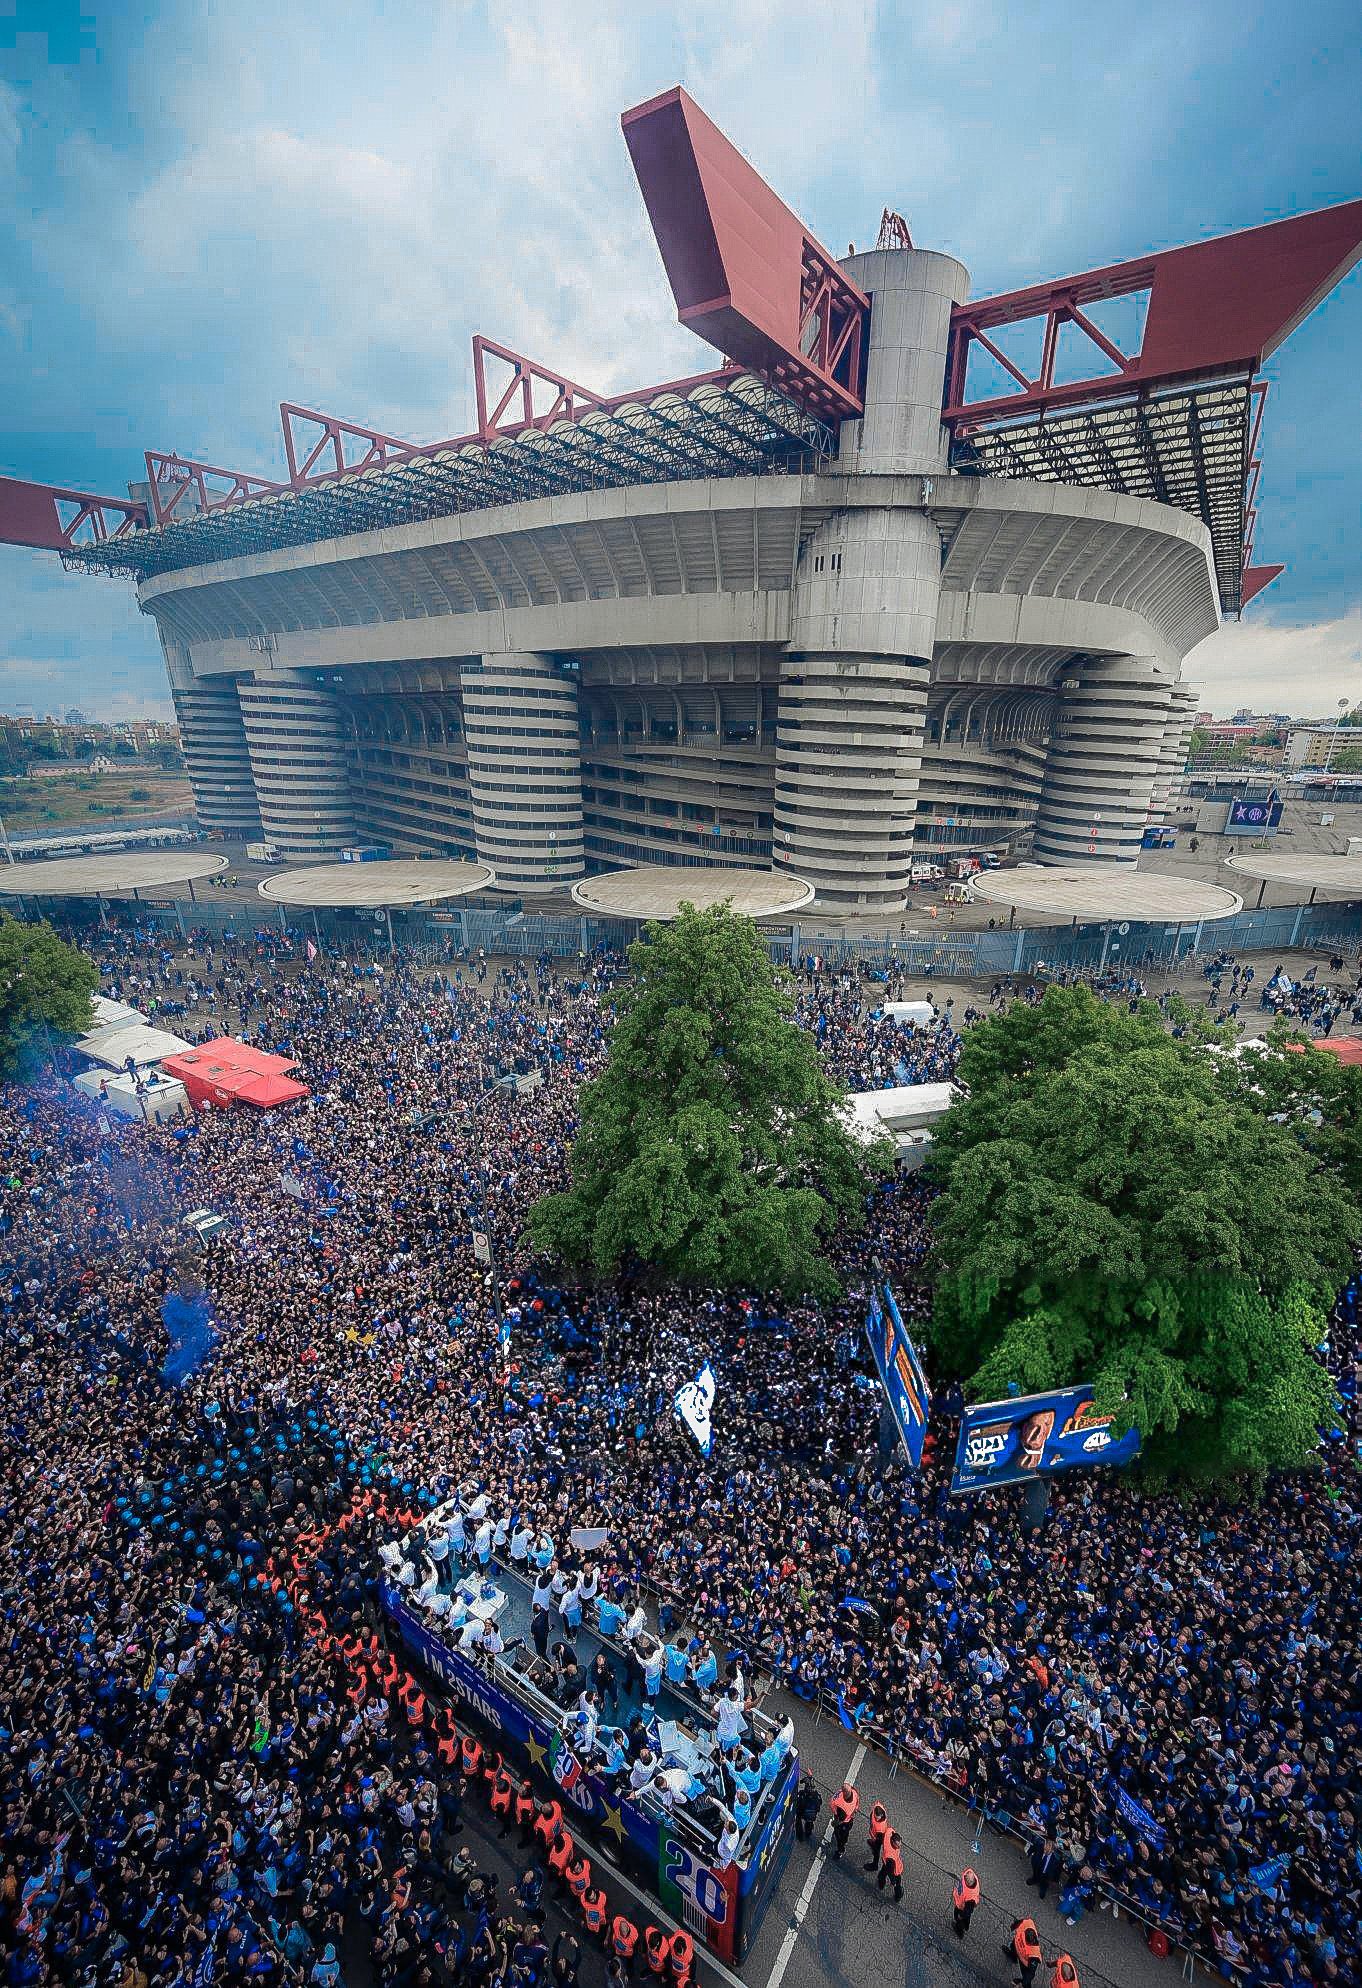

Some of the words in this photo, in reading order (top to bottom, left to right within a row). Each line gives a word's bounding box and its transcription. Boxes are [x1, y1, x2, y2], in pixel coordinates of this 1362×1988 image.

[431, 1654, 444, 1679] M
[446, 1668, 502, 1730] 2STARS
[554, 1740, 575, 1778] 20
[665, 1839, 728, 1924] 20
